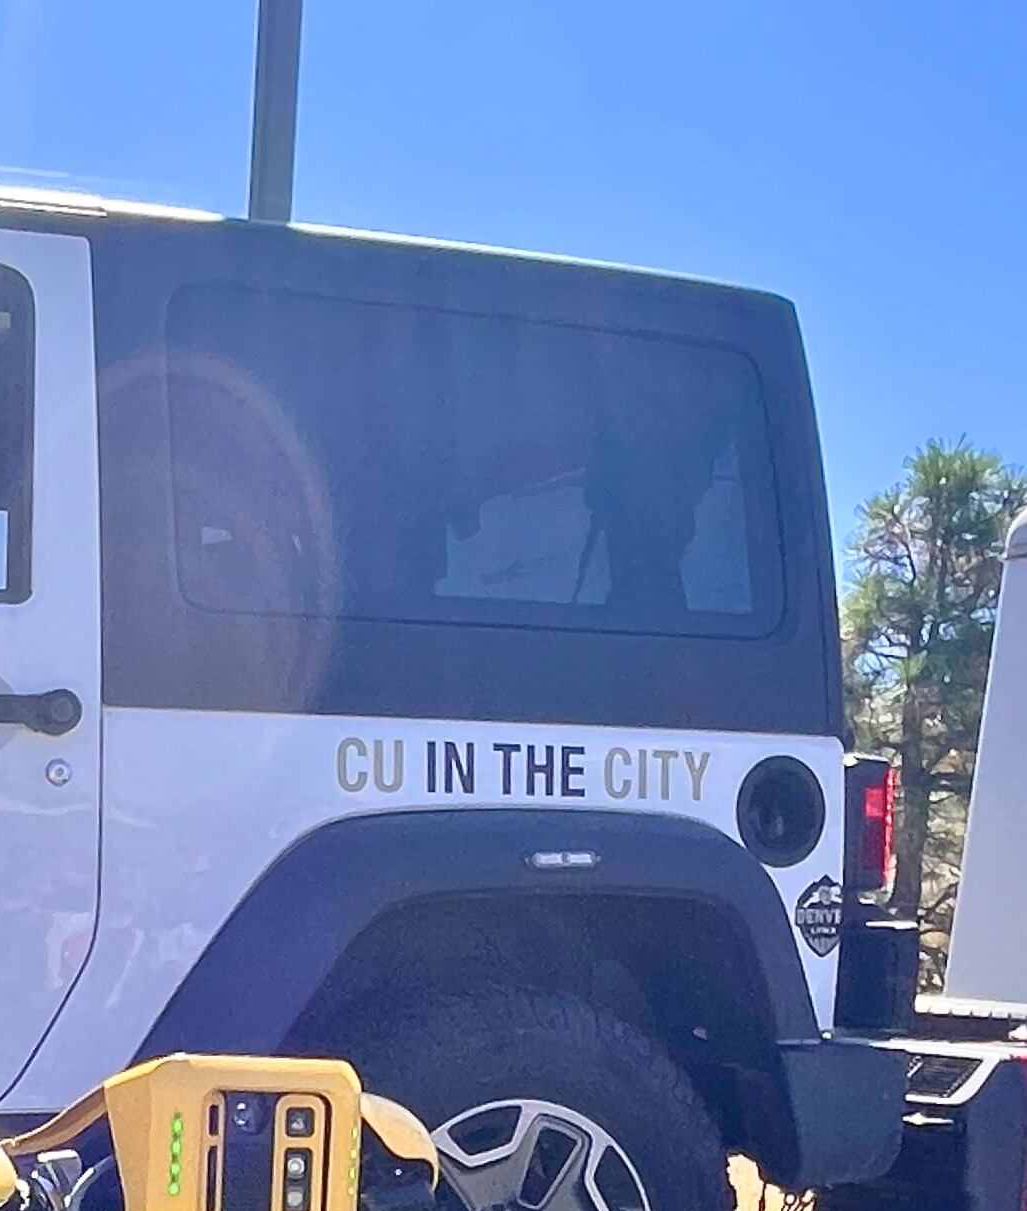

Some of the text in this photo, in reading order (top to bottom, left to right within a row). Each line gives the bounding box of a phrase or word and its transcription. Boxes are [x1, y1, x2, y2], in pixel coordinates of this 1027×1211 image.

[337, 737, 710, 801] CU IN THE CITY
[797, 908, 842, 925] DENVE
